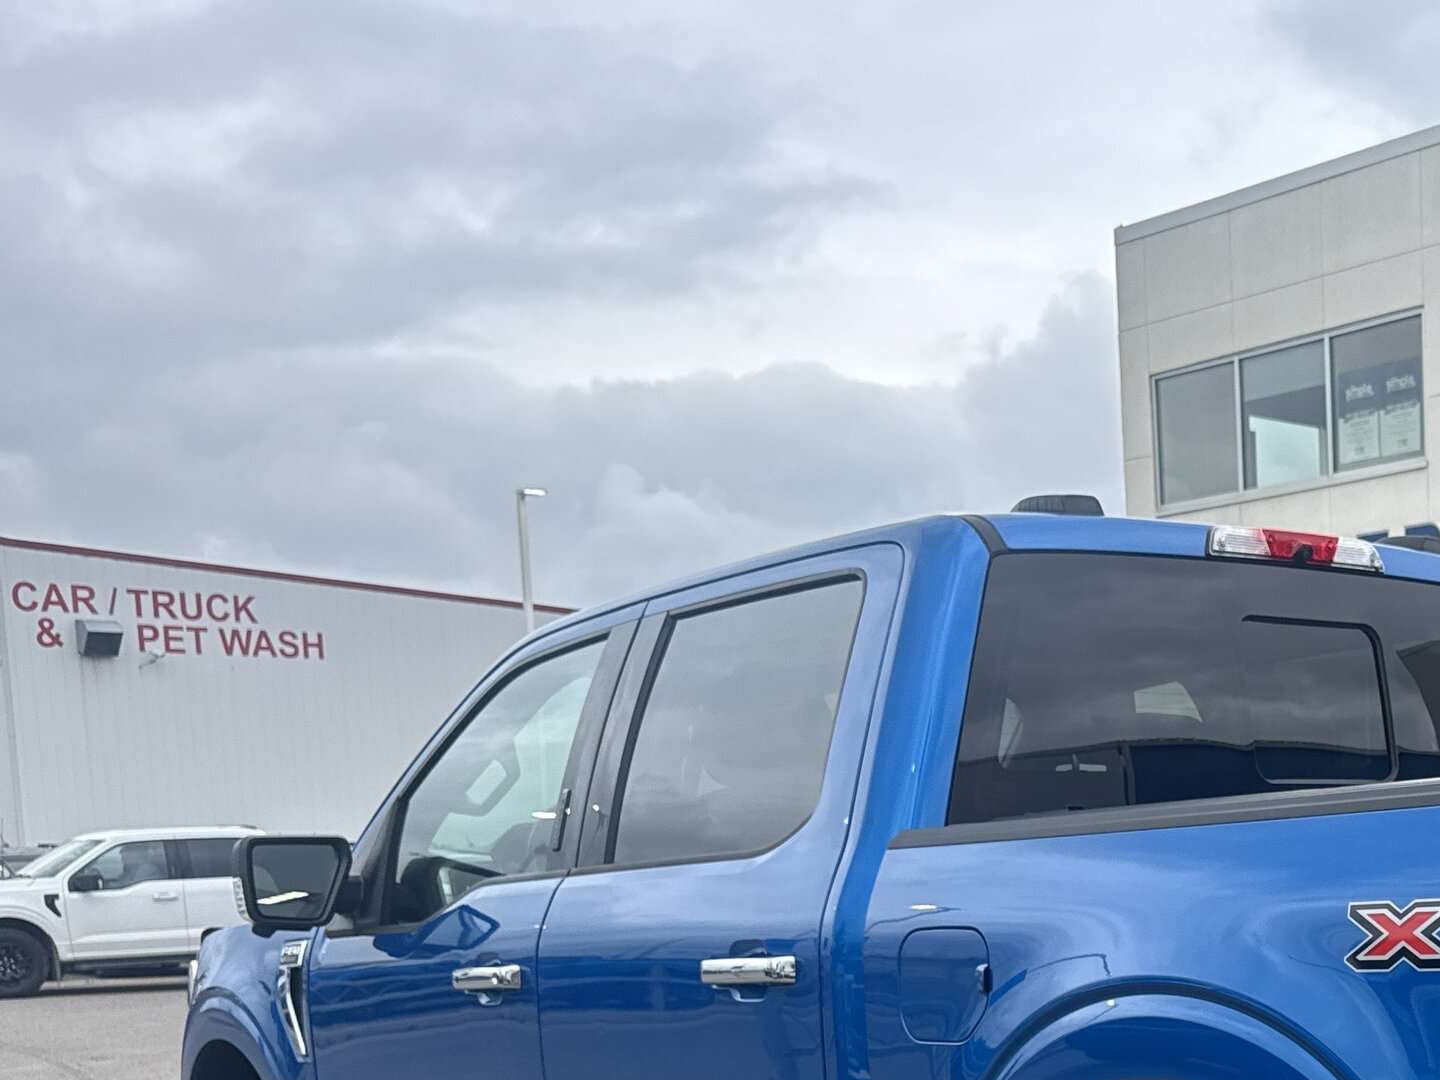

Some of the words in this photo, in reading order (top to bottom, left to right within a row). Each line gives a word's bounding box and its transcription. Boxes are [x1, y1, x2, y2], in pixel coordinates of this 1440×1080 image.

[11, 581, 98, 615] CAR
[126, 587, 258, 624] TRUCK
[36, 617, 64, 649] &
[137, 623, 209, 655] PET
[218, 627, 326, 660] WASH
